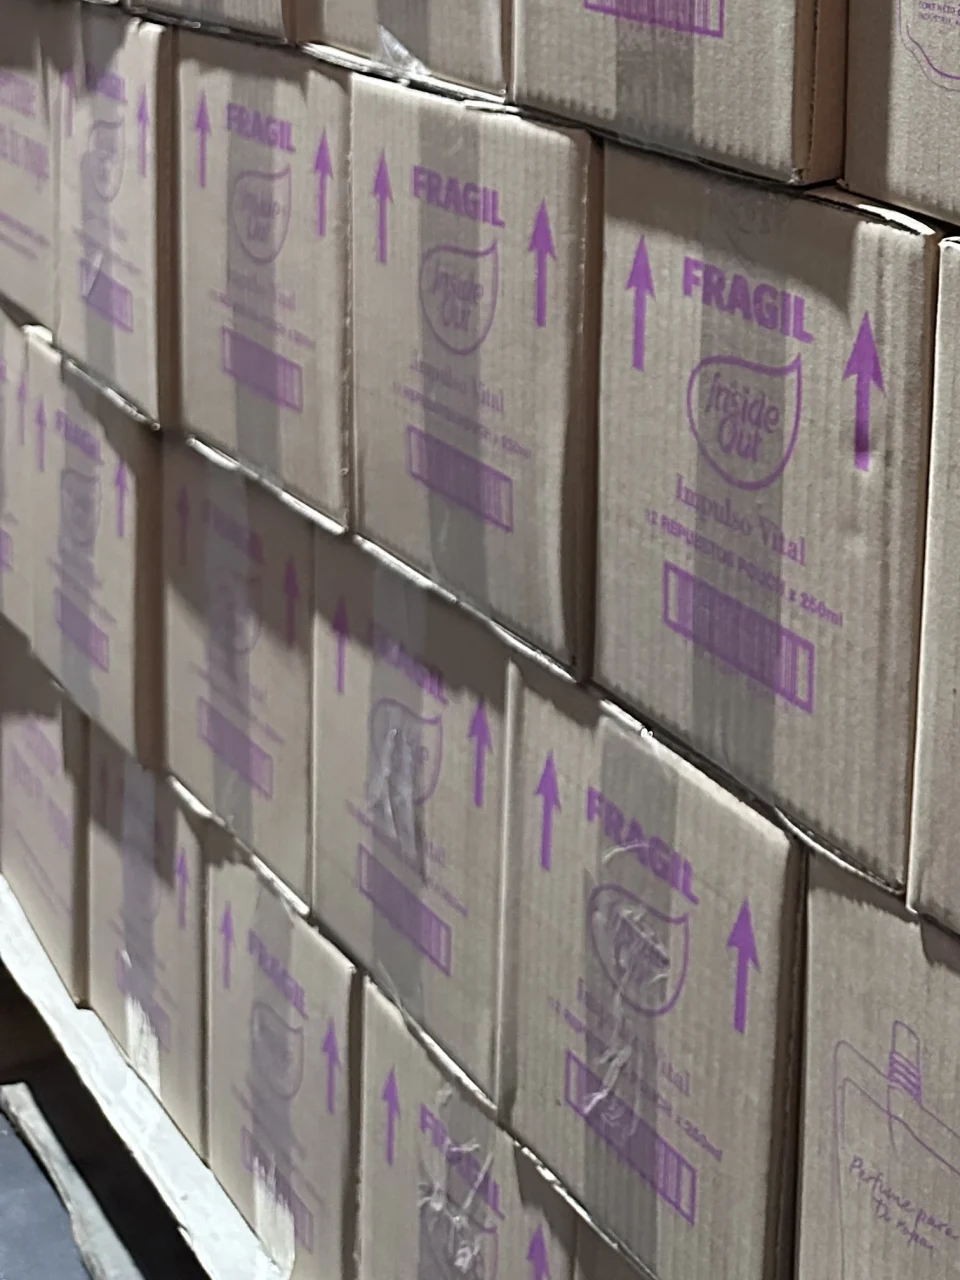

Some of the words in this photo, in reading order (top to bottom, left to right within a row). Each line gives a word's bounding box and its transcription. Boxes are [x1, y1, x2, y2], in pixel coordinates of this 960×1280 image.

[413, 165, 505, 228] FRAGIL
[683, 255, 814, 344] FRAGIL
[706, 372, 779, 434] Inside
[717, 417, 762, 463] Out
[587, 786, 699, 905] FRAGIL
